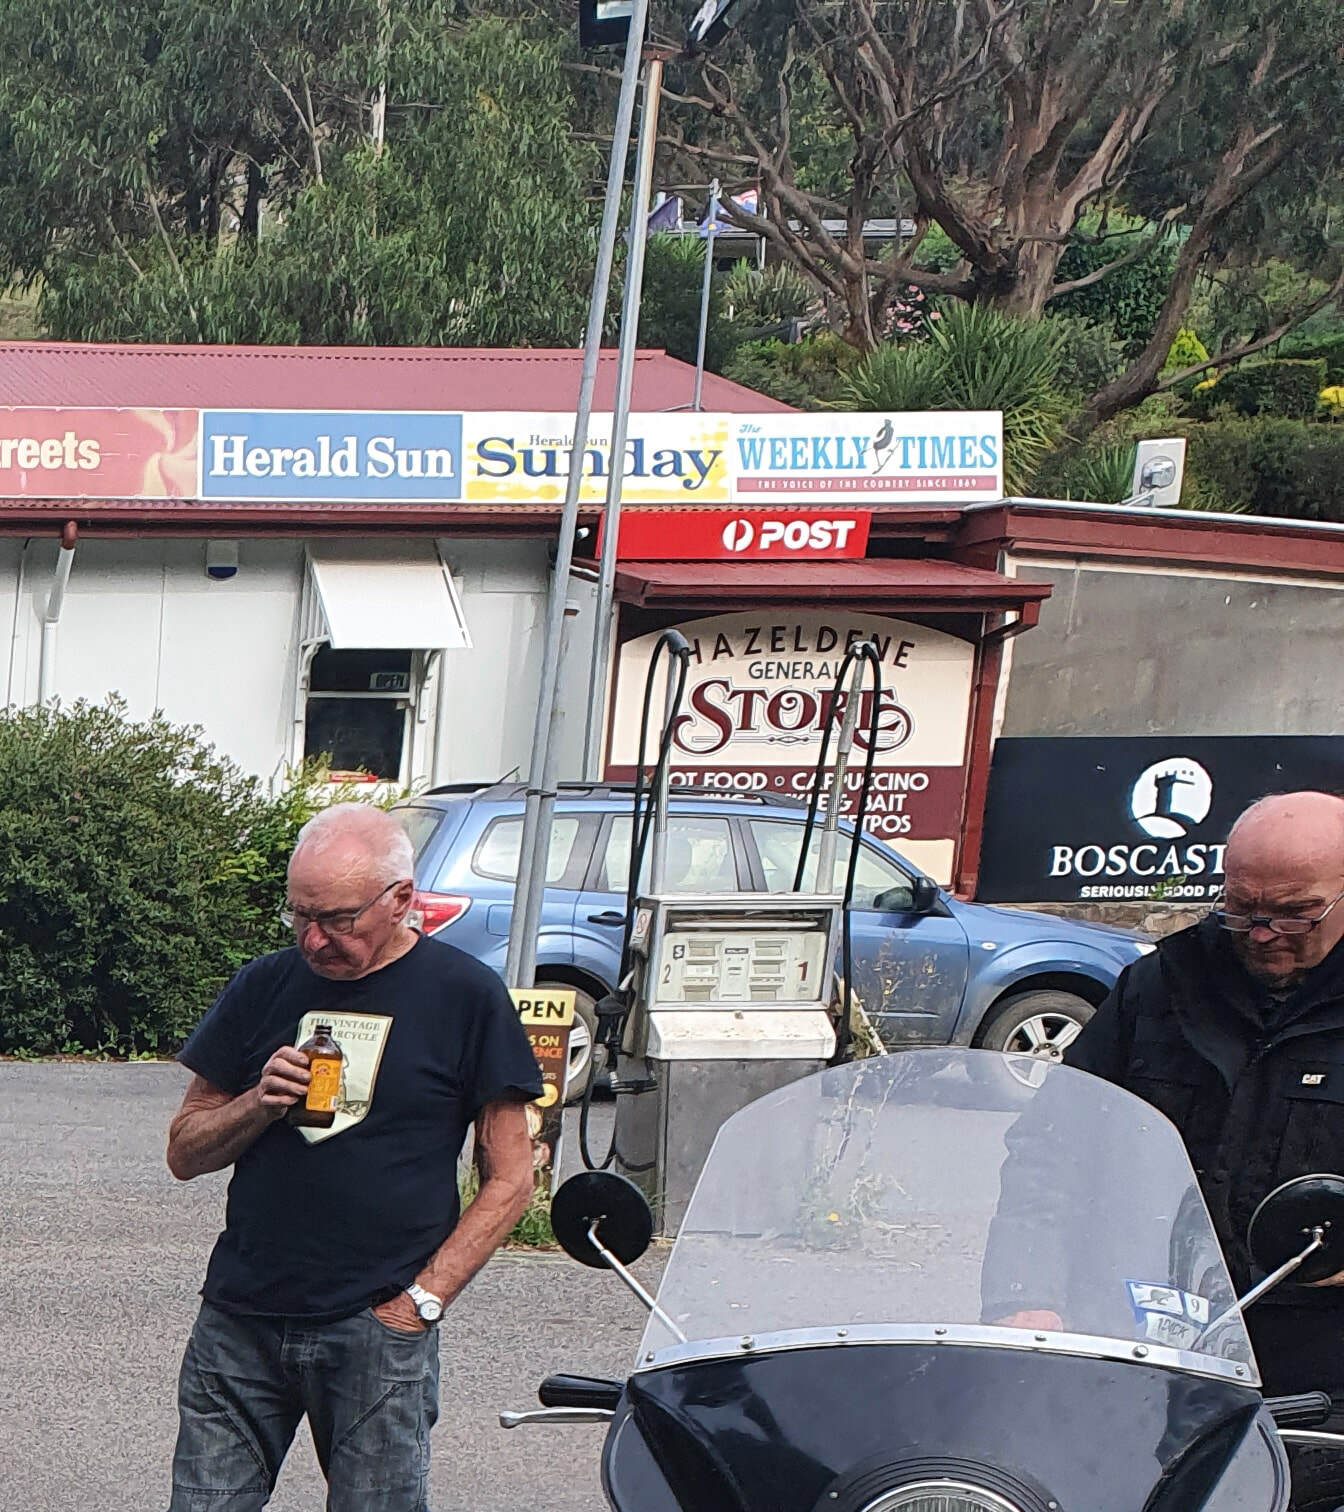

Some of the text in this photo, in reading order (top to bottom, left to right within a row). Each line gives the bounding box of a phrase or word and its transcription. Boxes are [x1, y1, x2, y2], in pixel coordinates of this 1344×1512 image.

[208, 434, 455, 479] Herald Sun
[476, 436, 724, 490] Sunday
[736, 434, 998, 471] WEEKLY TIMES
[757, 479, 777, 490] THE
[783, 479, 813, 490] VOICE
[819, 479, 833, 490] OF
[839, 479, 858, 489] THE
[863, 478, 911, 489] COUNTRY
[916, 478, 948, 488] SINCE
[759, 519, 857, 550] POST
[668, 771, 699, 787] OT
[703, 771, 768, 791] FOOD
[837, 814, 912, 834] TPOS
[1049, 844, 1228, 877] BOSCAST
[662, 963, 672, 985] 2
[798, 960, 809, 982] 1
[518, 1000, 566, 1019] PEN
[333, 1019, 381, 1031] VINTAGE
[538, 1035, 560, 1047] ON
